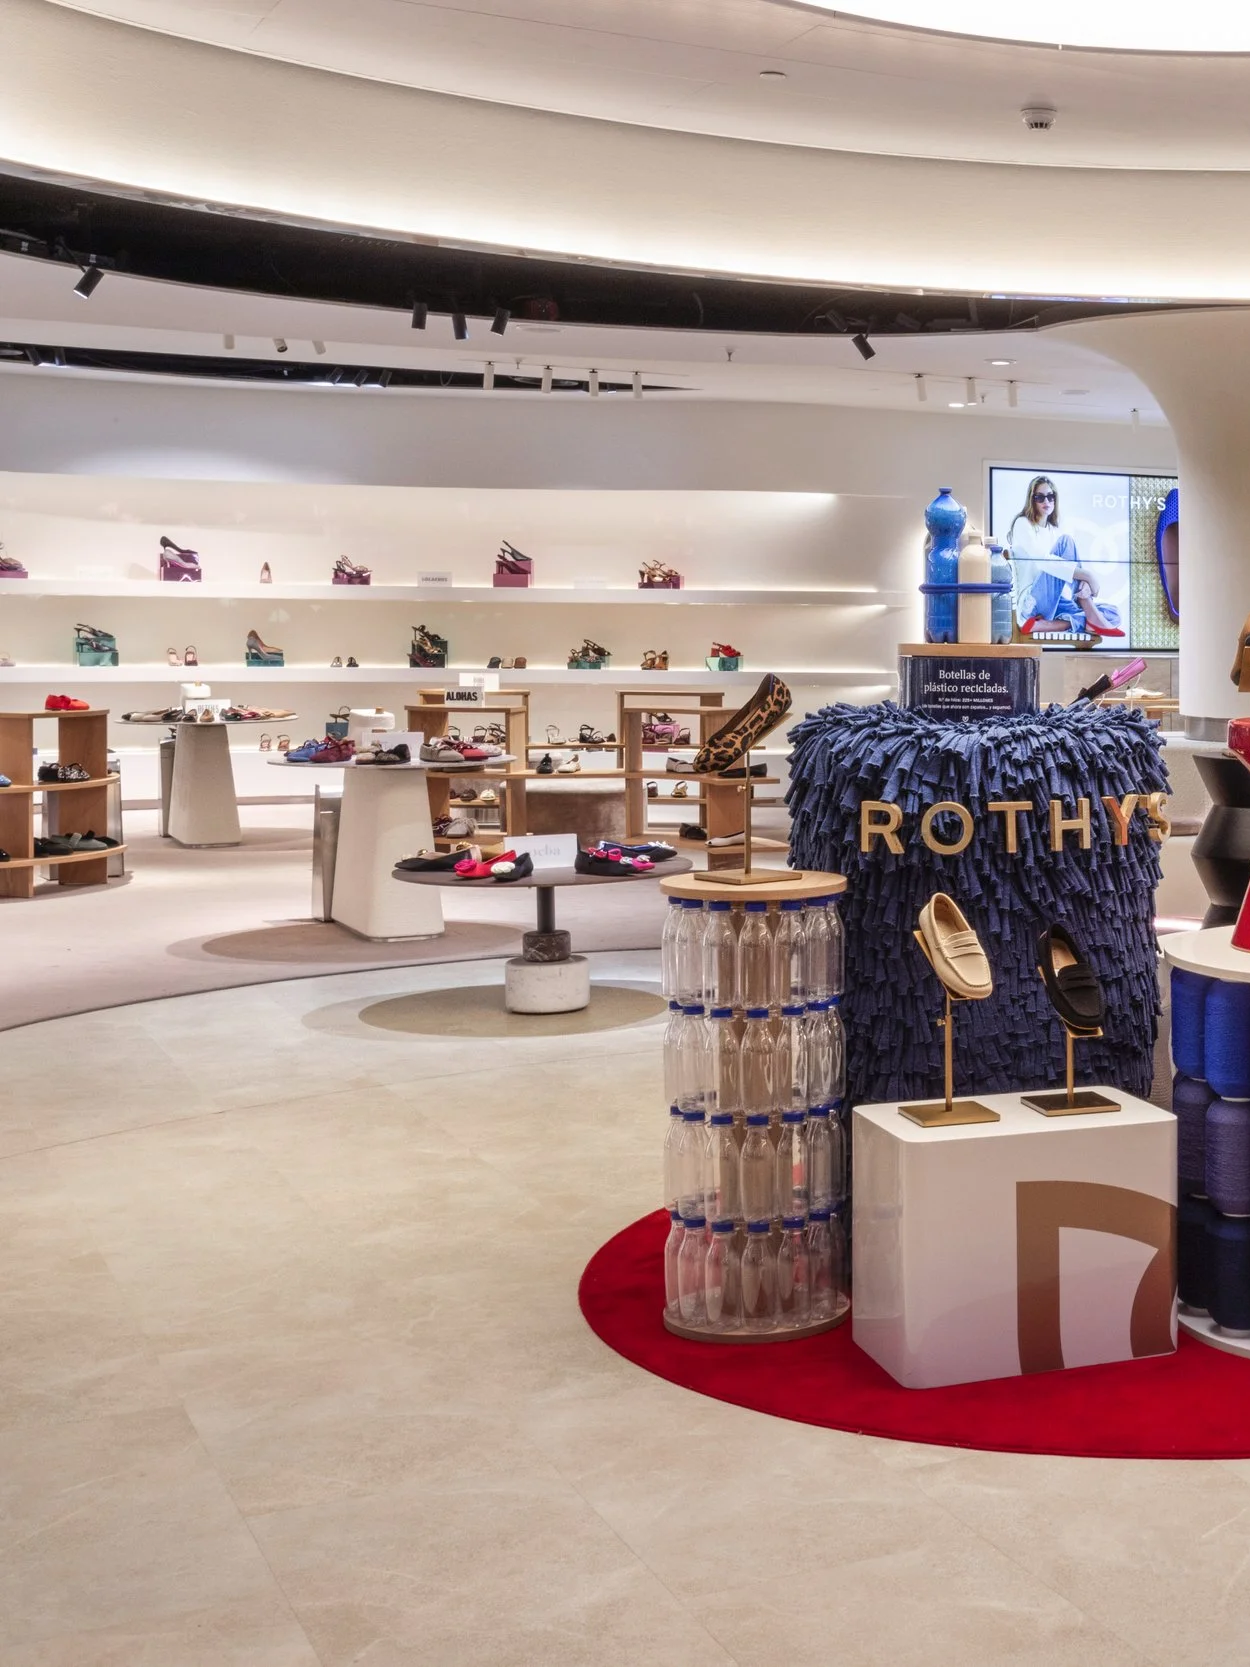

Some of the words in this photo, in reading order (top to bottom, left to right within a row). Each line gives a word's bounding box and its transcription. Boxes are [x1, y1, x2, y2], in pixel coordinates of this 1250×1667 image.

[1092, 494, 1166, 511] ROTHY'S
[939, 669, 976, 680] Botellas
[978, 669, 991, 680] de
[924, 682, 958, 694] plástico
[961, 683, 1009, 693] recicladas.
[446, 691, 478, 701] ALOHAS
